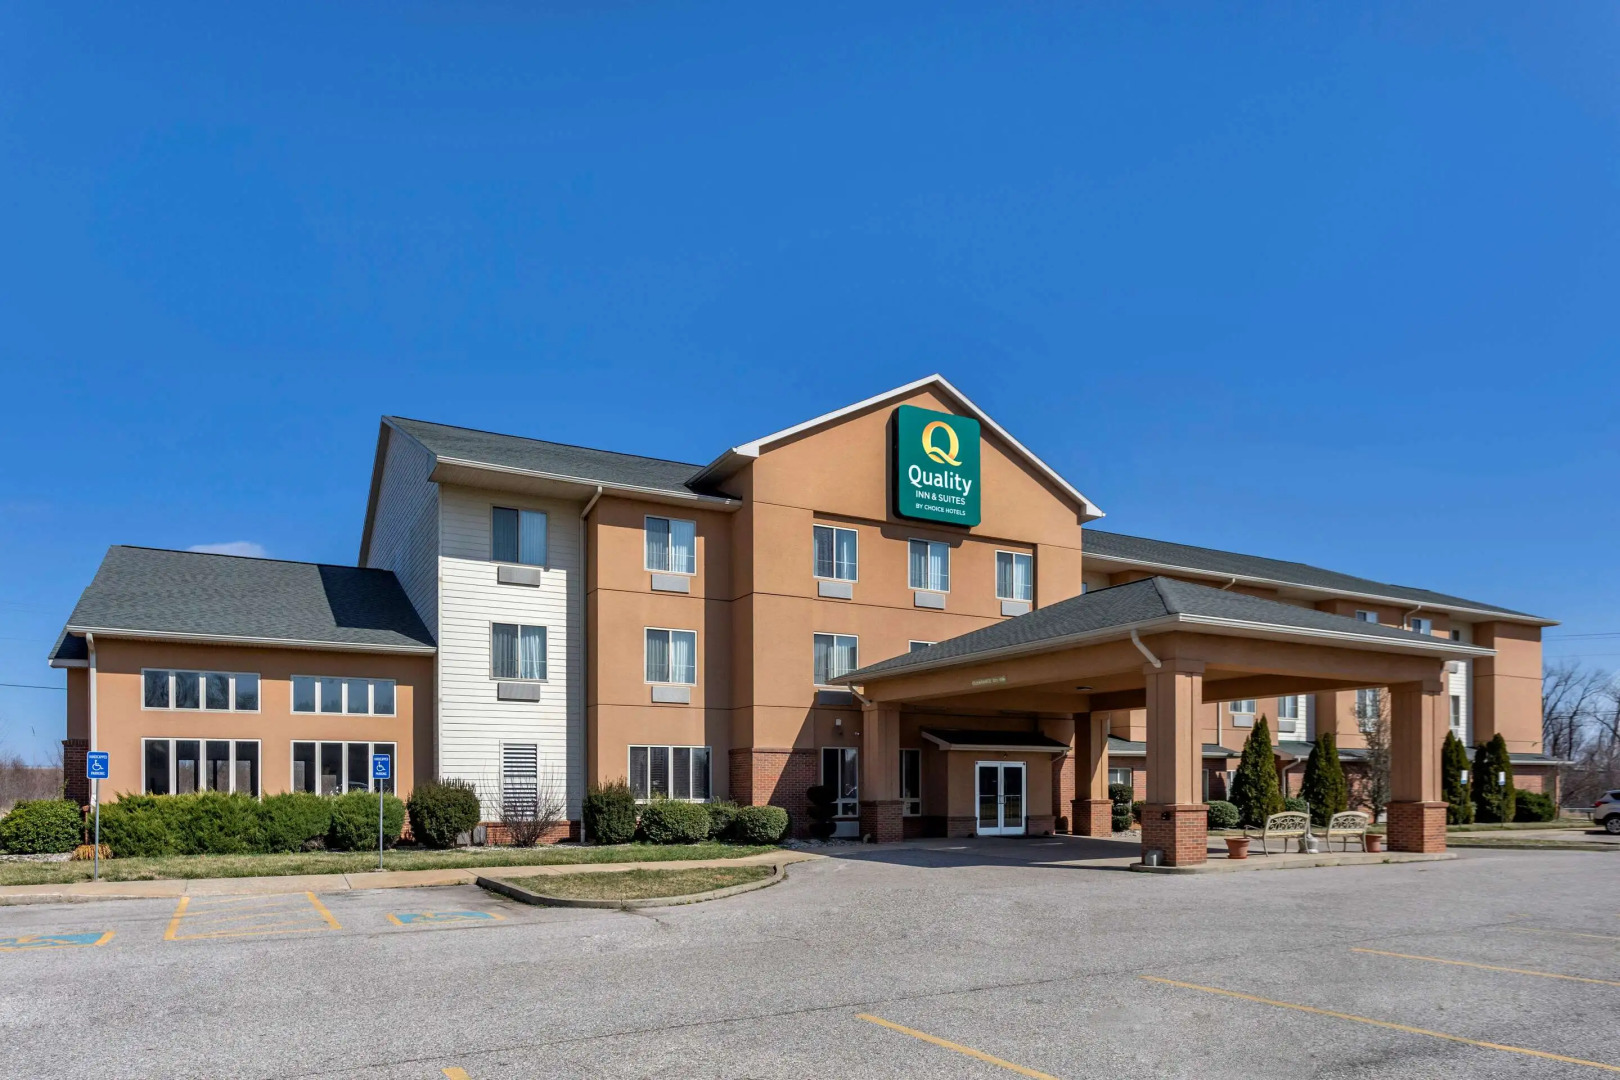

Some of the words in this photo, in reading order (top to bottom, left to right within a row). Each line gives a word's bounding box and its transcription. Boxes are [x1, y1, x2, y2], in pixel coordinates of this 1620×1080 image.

[922, 420, 963, 467] Q
[908, 464, 972, 496] Quality
[915, 490, 930, 499] INN
[931, 492, 937, 501] &
[938, 493, 966, 506] SUITES
[924, 504, 945, 513] CHOICE
[945, 507, 966, 516] HOTELS
